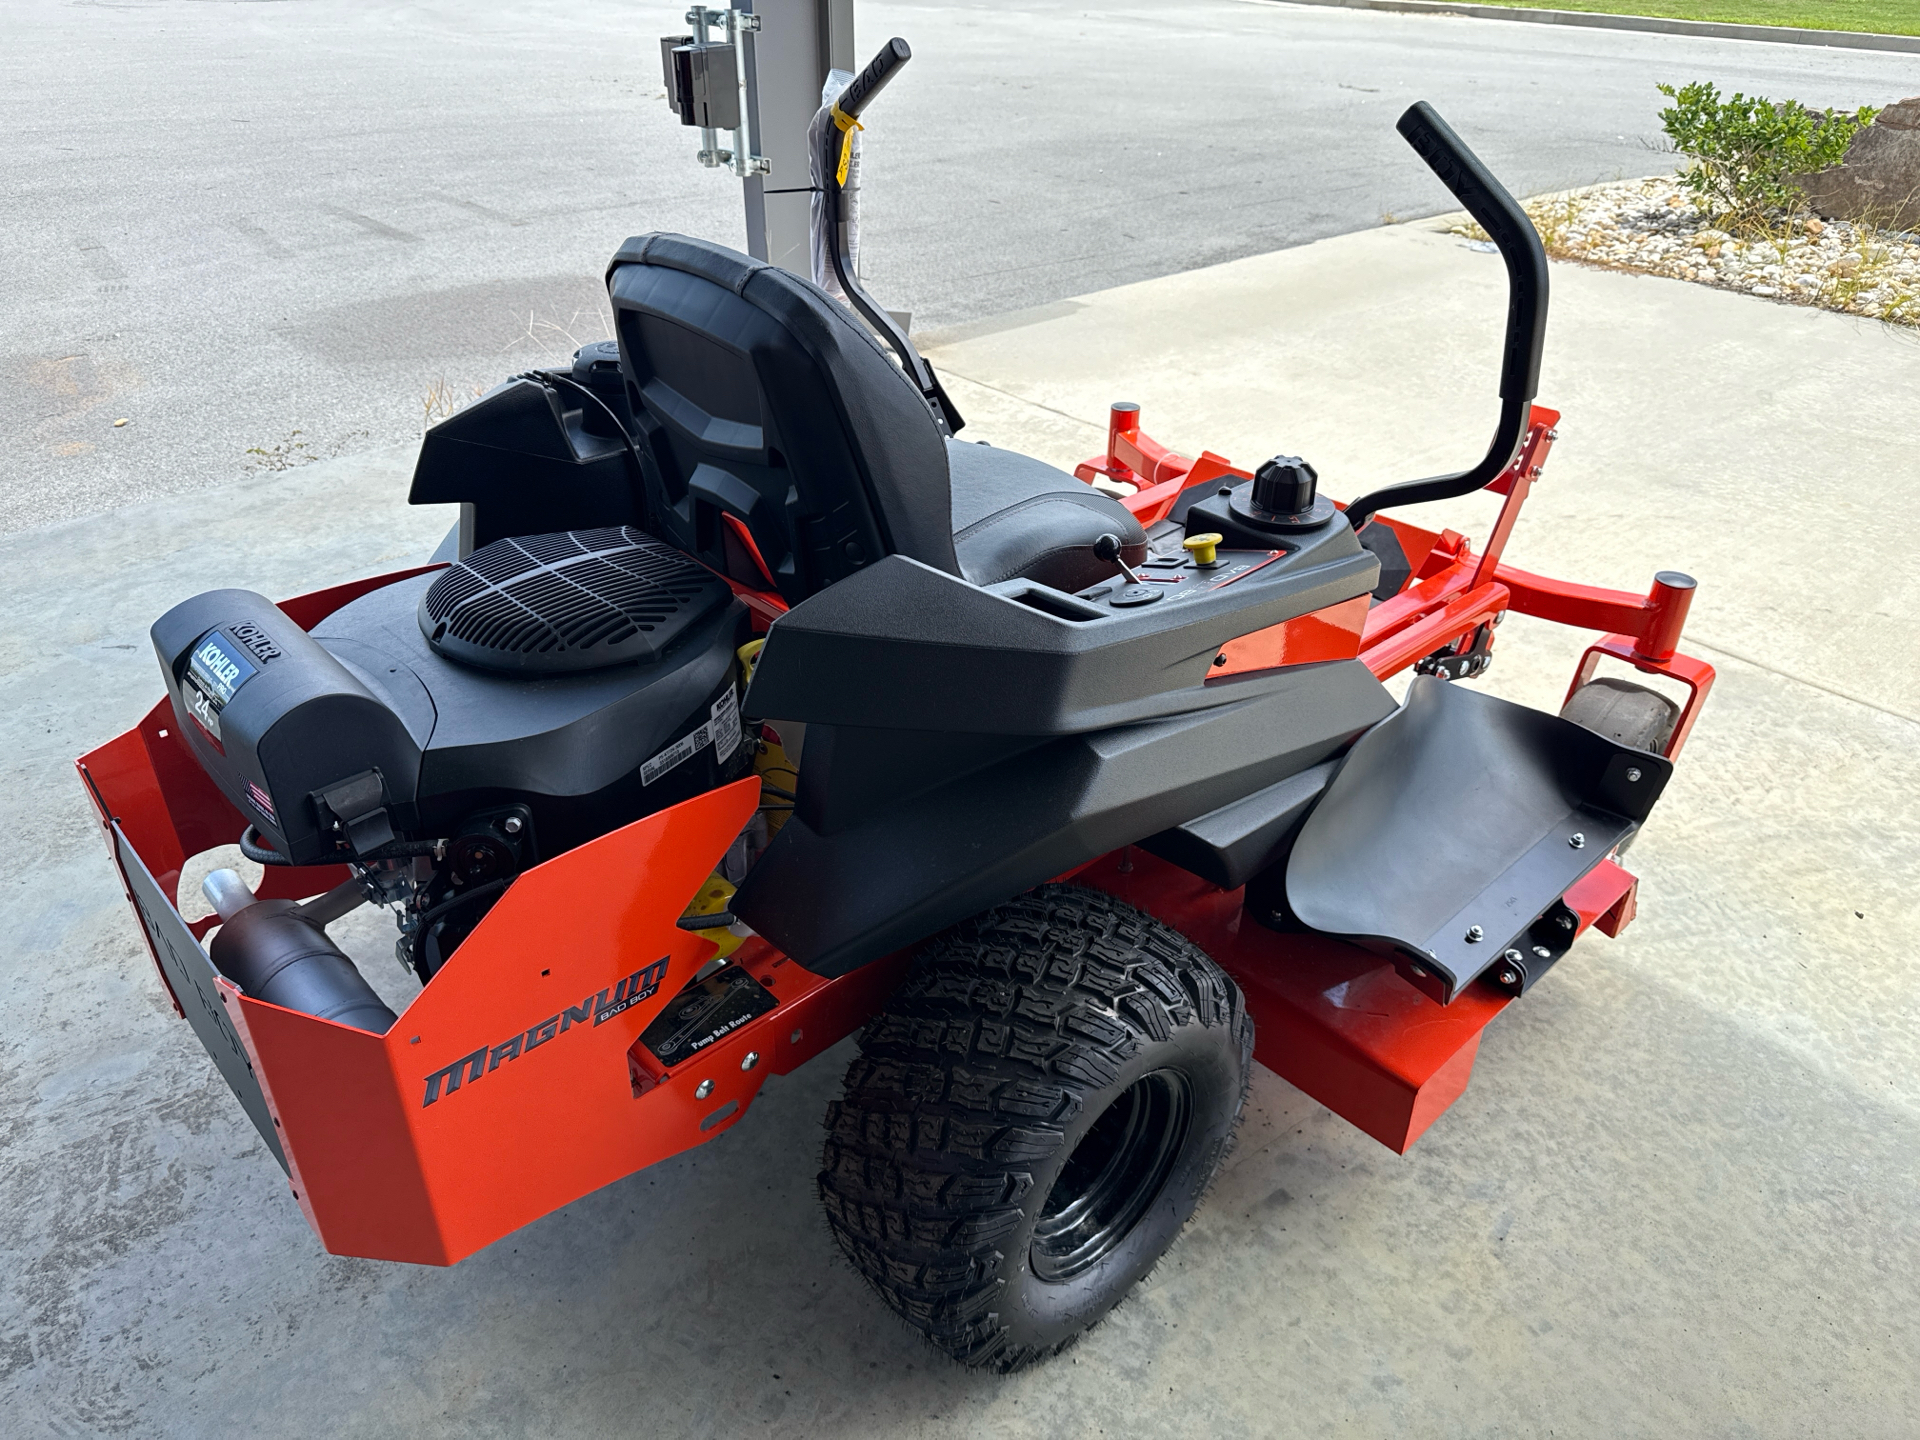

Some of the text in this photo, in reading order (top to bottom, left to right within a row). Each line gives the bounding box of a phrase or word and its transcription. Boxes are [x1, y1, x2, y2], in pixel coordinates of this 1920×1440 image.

[1407, 124, 1478, 198] BOY
[228, 621, 282, 665] KOHLER
[199, 641, 240, 688] KOHLER
[194, 690, 210, 721] 24
[216, 682, 228, 695] PRO
[600, 985, 656, 1022] BAD BOY
[422, 954, 671, 1108] MAGNUM
[690, 1012, 753, 1050] Pump Belt Route
